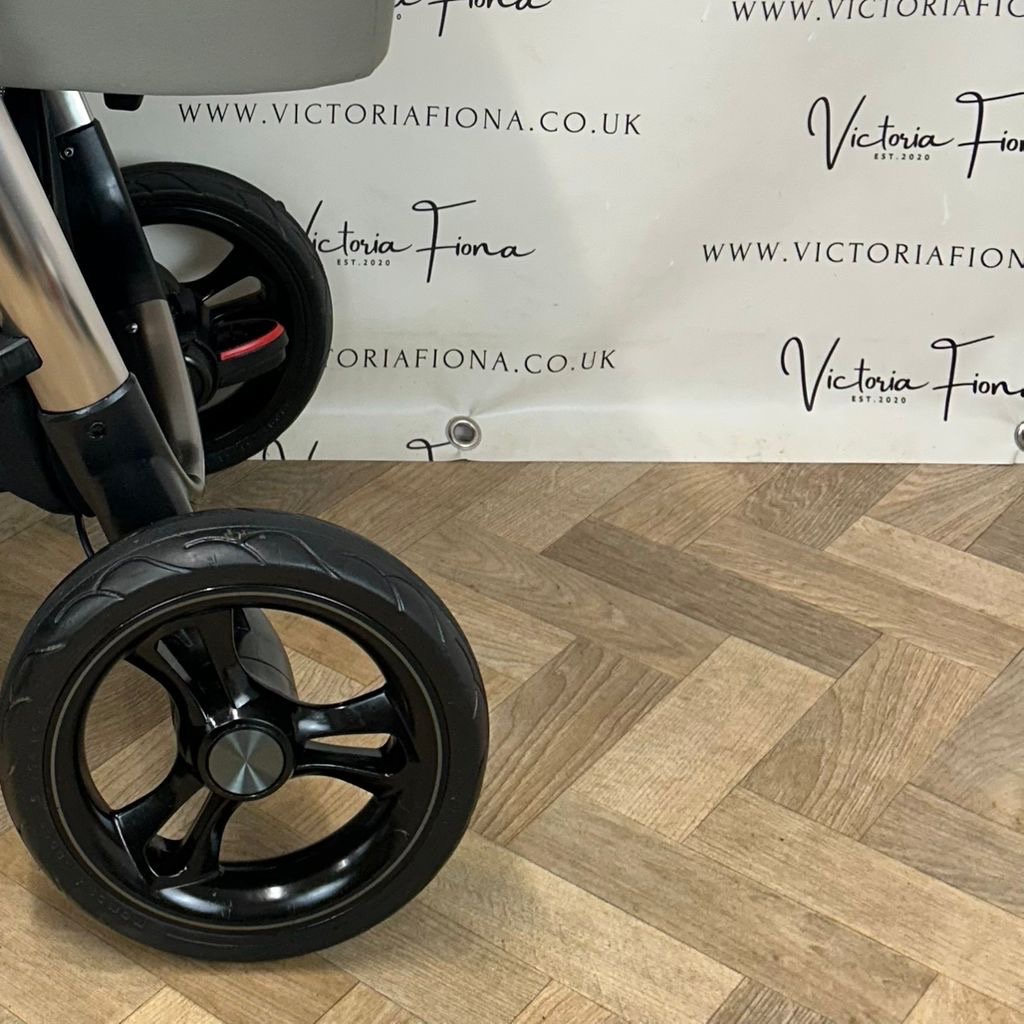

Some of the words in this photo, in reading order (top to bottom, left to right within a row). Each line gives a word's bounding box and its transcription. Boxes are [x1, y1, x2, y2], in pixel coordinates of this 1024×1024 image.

[178, 102, 642, 136] WWW.VICTORIAFIONA.CO.UK
[806, 94, 954, 171] Victoria
[873, 152, 931, 162] EST.2020
[411, 199, 537, 284] Fiona
[336, 258, 391, 267] EST.2020
[780, 336, 930, 413] Victoria
[930, 334, 1024, 423] Fion
[851, 395, 907, 405] EST.2020
